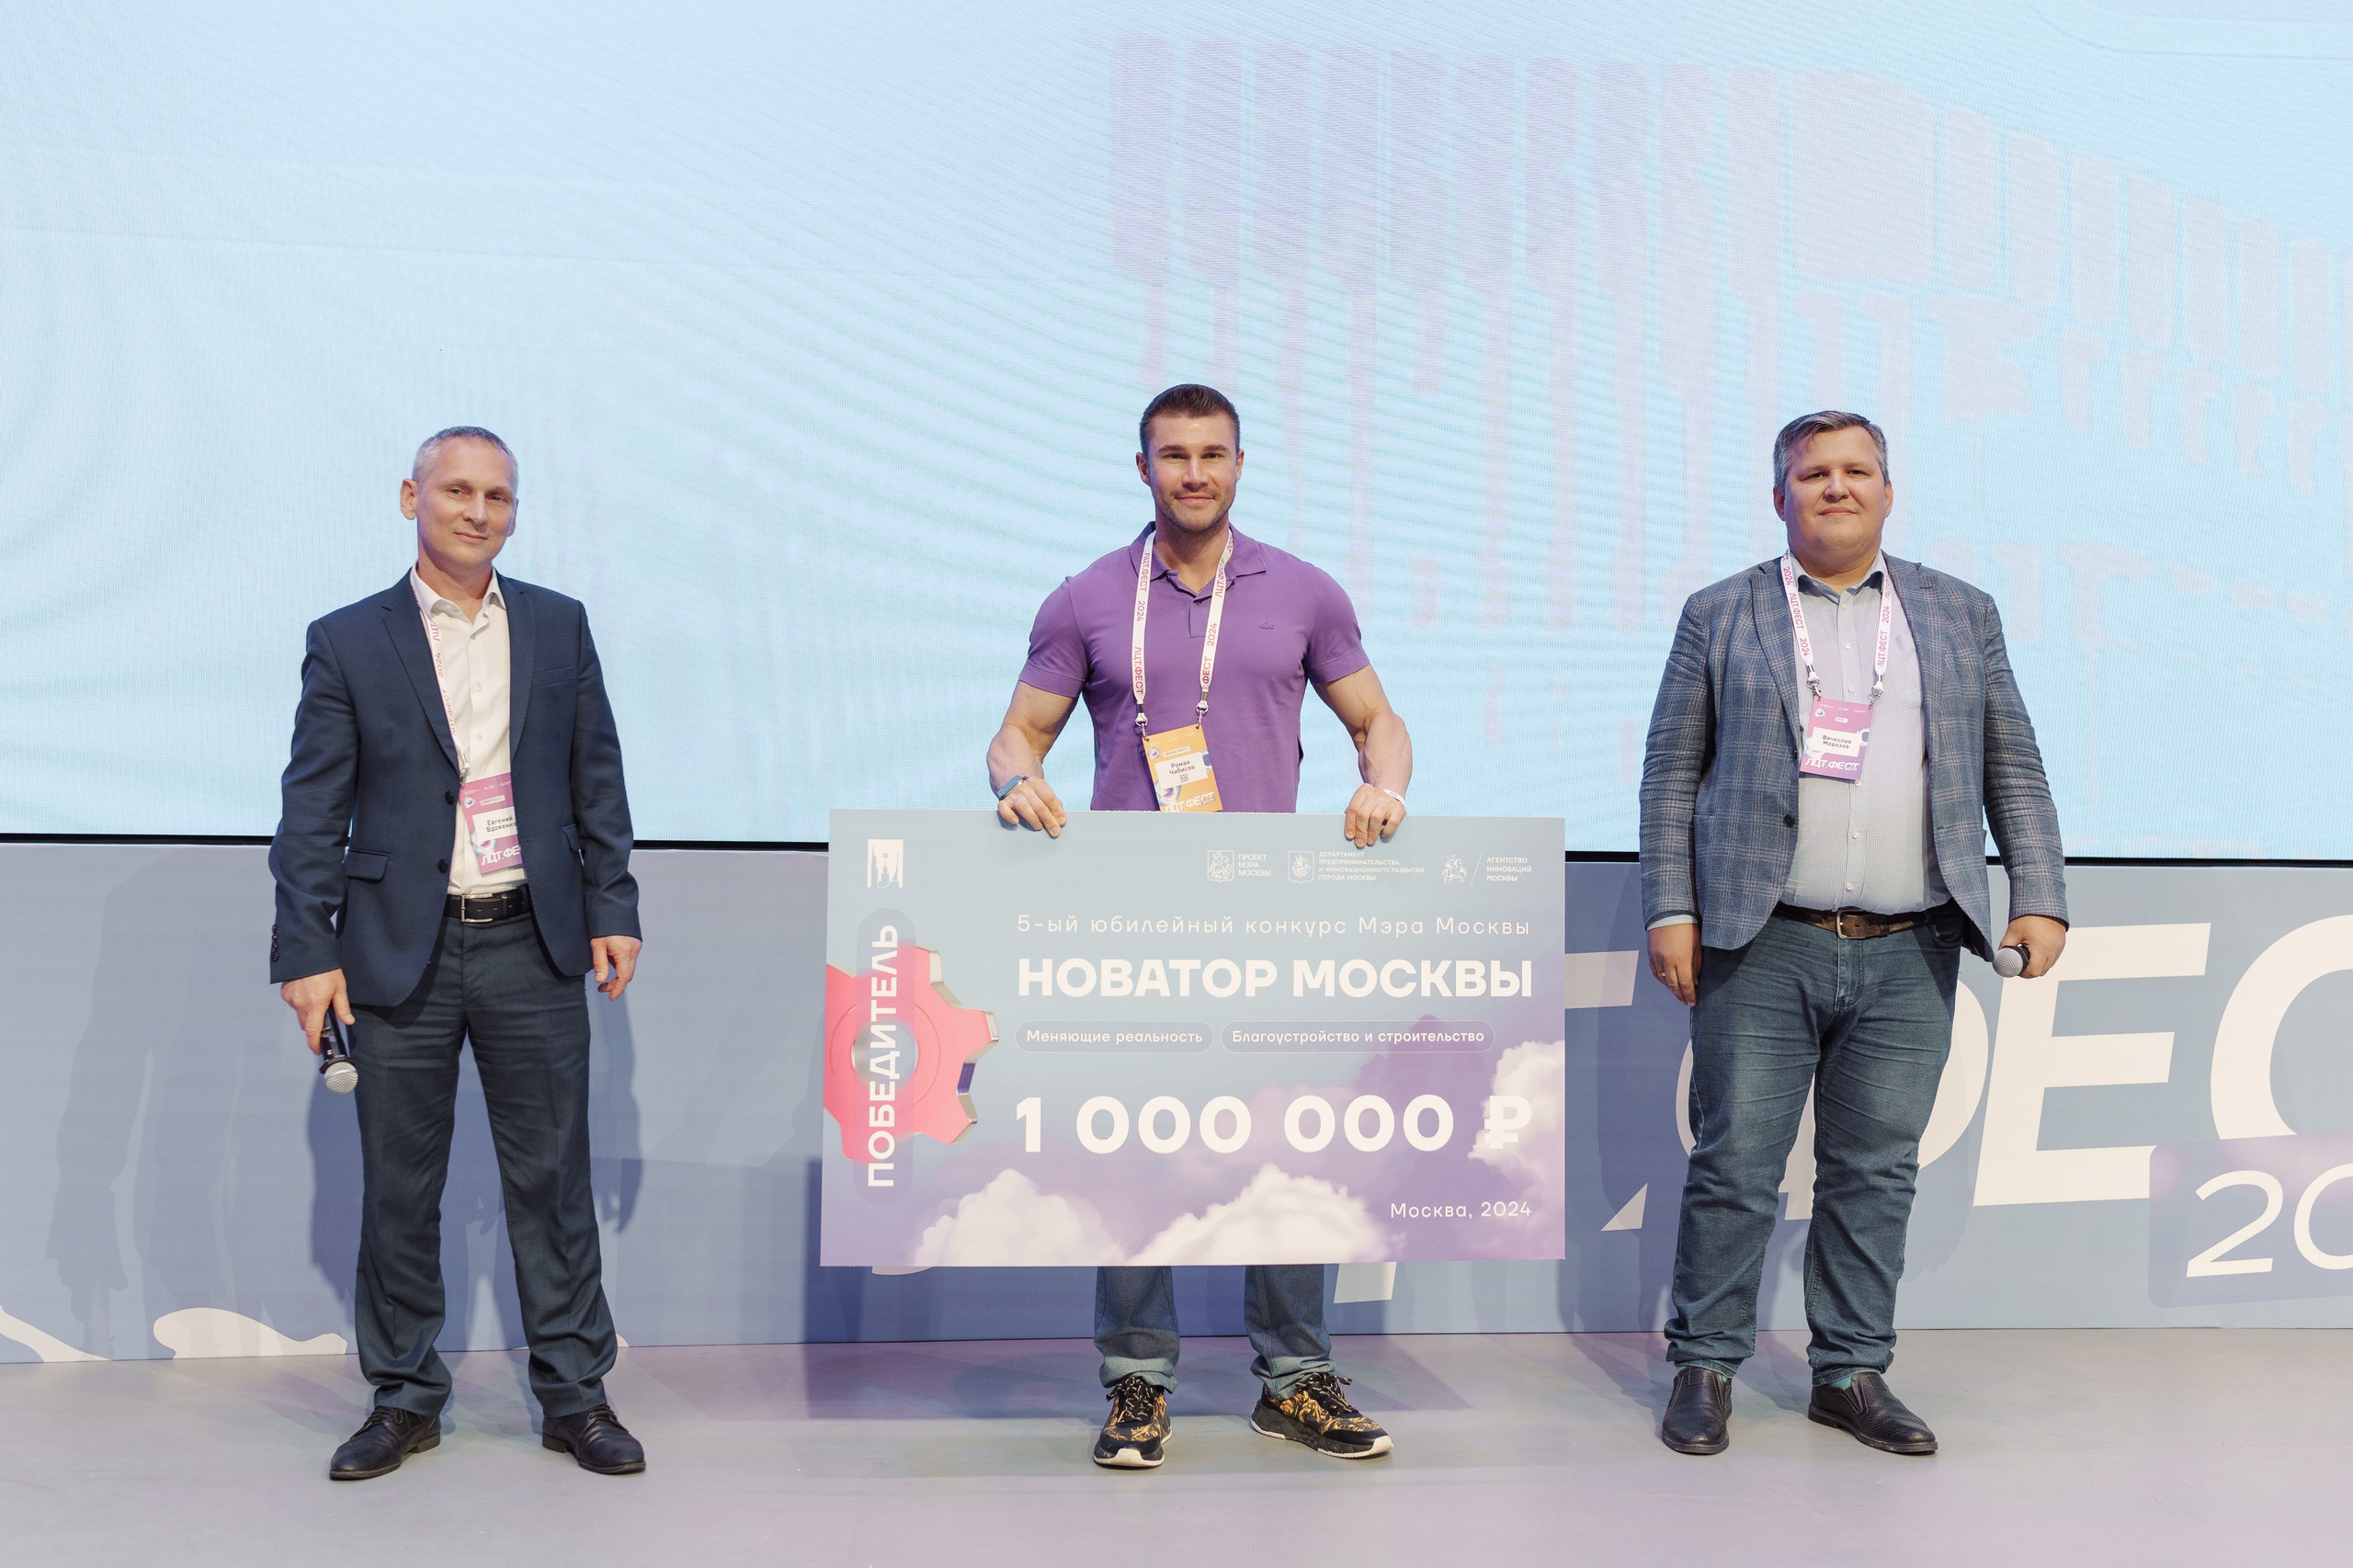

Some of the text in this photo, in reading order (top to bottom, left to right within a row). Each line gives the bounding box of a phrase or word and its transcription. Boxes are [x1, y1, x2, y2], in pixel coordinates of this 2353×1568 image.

[1136, 600, 1146, 622] 2024
[1783, 566, 1794, 586] 2024
[1789, 593, 1805, 630] ЛЦТ.ФЕСТ
[1799, 637, 1811, 656] 2024
[1881, 605, 1891, 624] 2024
[1206, 622, 1218, 647] 2024
[1877, 630, 1888, 667] ЛЦТ.ФЕСТ
[435, 653, 445, 678] 2024
[1133, 646, 1143, 695] ЛЦТ.ФЕСТ
[1822, 734, 1852, 744] Вячеслав
[1822, 740, 1850, 749] Морозов
[1168, 765, 1196, 775] Чибисов
[1170, 760, 1191, 769] Роман
[1804, 757, 1859, 770] ЛЦТ.ФЕСТ
[485, 822, 517, 833] Вдовенко
[486, 815, 514, 826] Евгений
[481, 845, 520, 866] ЛЦТ.ФЕ
[1238, 869, 1271, 877] МОСКВЫ
[1486, 865, 1532, 874] ИННОВАЦИЙ
[1017, 914, 1529, 938] 5-ый юбилейный конкурс Мэра Москвы
[1018, 958, 1532, 998] НОВАТОР МОСКВЫ
[1027, 1029, 1203, 1045] Меняющие реальность
[1233, 1029, 1484, 1045] Благоустройство и строительство
[867, 925, 899, 1187] ПОБЕДИТЕЛЬ
[1017, 1097, 1041, 1153] 1
[1076, 1096, 1252, 1154] 000
[1284, 1094, 1454, 1153] 000
[1391, 1200, 1532, 1220] Москва, 2024
